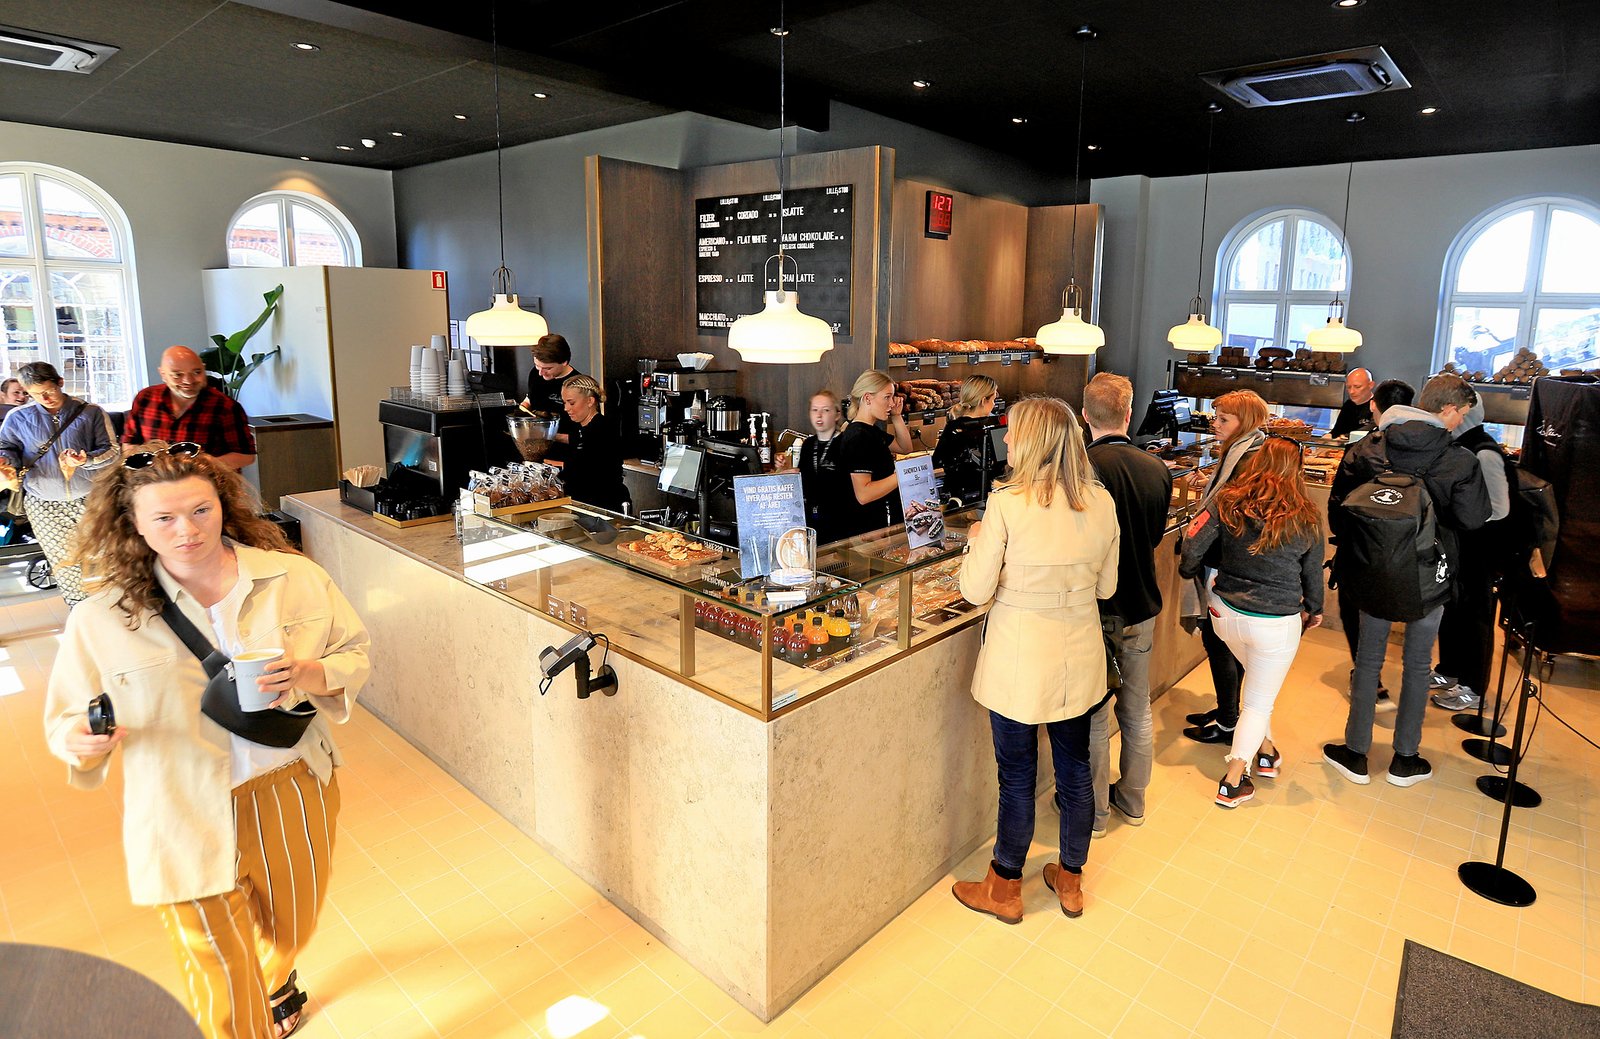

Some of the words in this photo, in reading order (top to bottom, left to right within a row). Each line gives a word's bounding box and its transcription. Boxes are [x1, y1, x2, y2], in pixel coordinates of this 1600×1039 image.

[700, 213, 715, 223] FILTER
[699, 236, 726, 246] AMERICANO
[737, 235, 750, 245] FLAT
[751, 234, 768, 244] WHITE
[799, 231, 834, 241] CHOKOLADE
[698, 274, 723, 283] ESPRESSO
[737, 274, 754, 283] LATTE
[796, 273, 815, 283] LATTE
[743, 486, 756, 494] VIND
[757, 485, 777, 493] GRATIS
[777, 484, 794, 492] KAFFE
[746, 494, 760, 502] HVER
[773, 492, 793, 500] RESTEN
[768, 500, 781, 508] ÅRET
